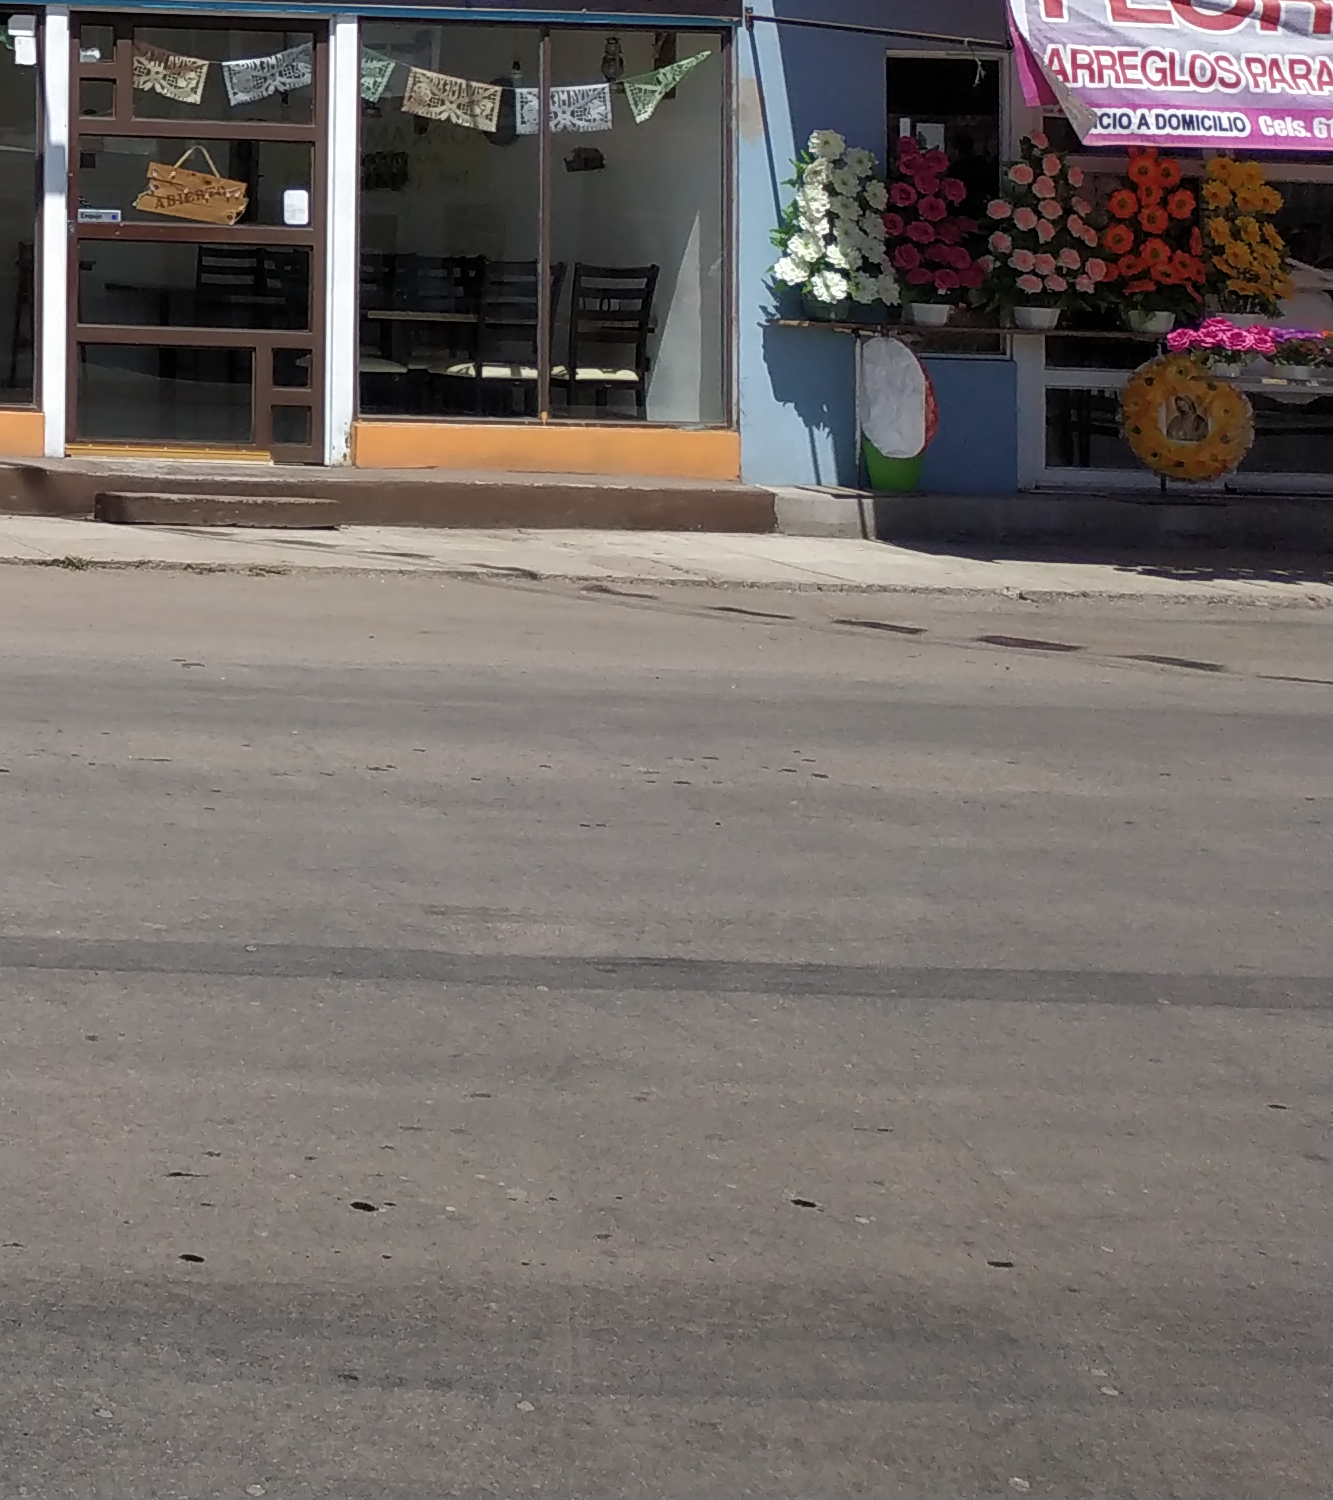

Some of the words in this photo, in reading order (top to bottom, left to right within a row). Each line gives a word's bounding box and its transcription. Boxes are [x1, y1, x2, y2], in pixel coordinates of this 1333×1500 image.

[1047, 47, 1242, 88] ARREGLOS
[1136, 112, 1151, 131] A
[1155, 112, 1247, 133] DOMICILIO
[1258, 115, 1311, 138] Cels.
